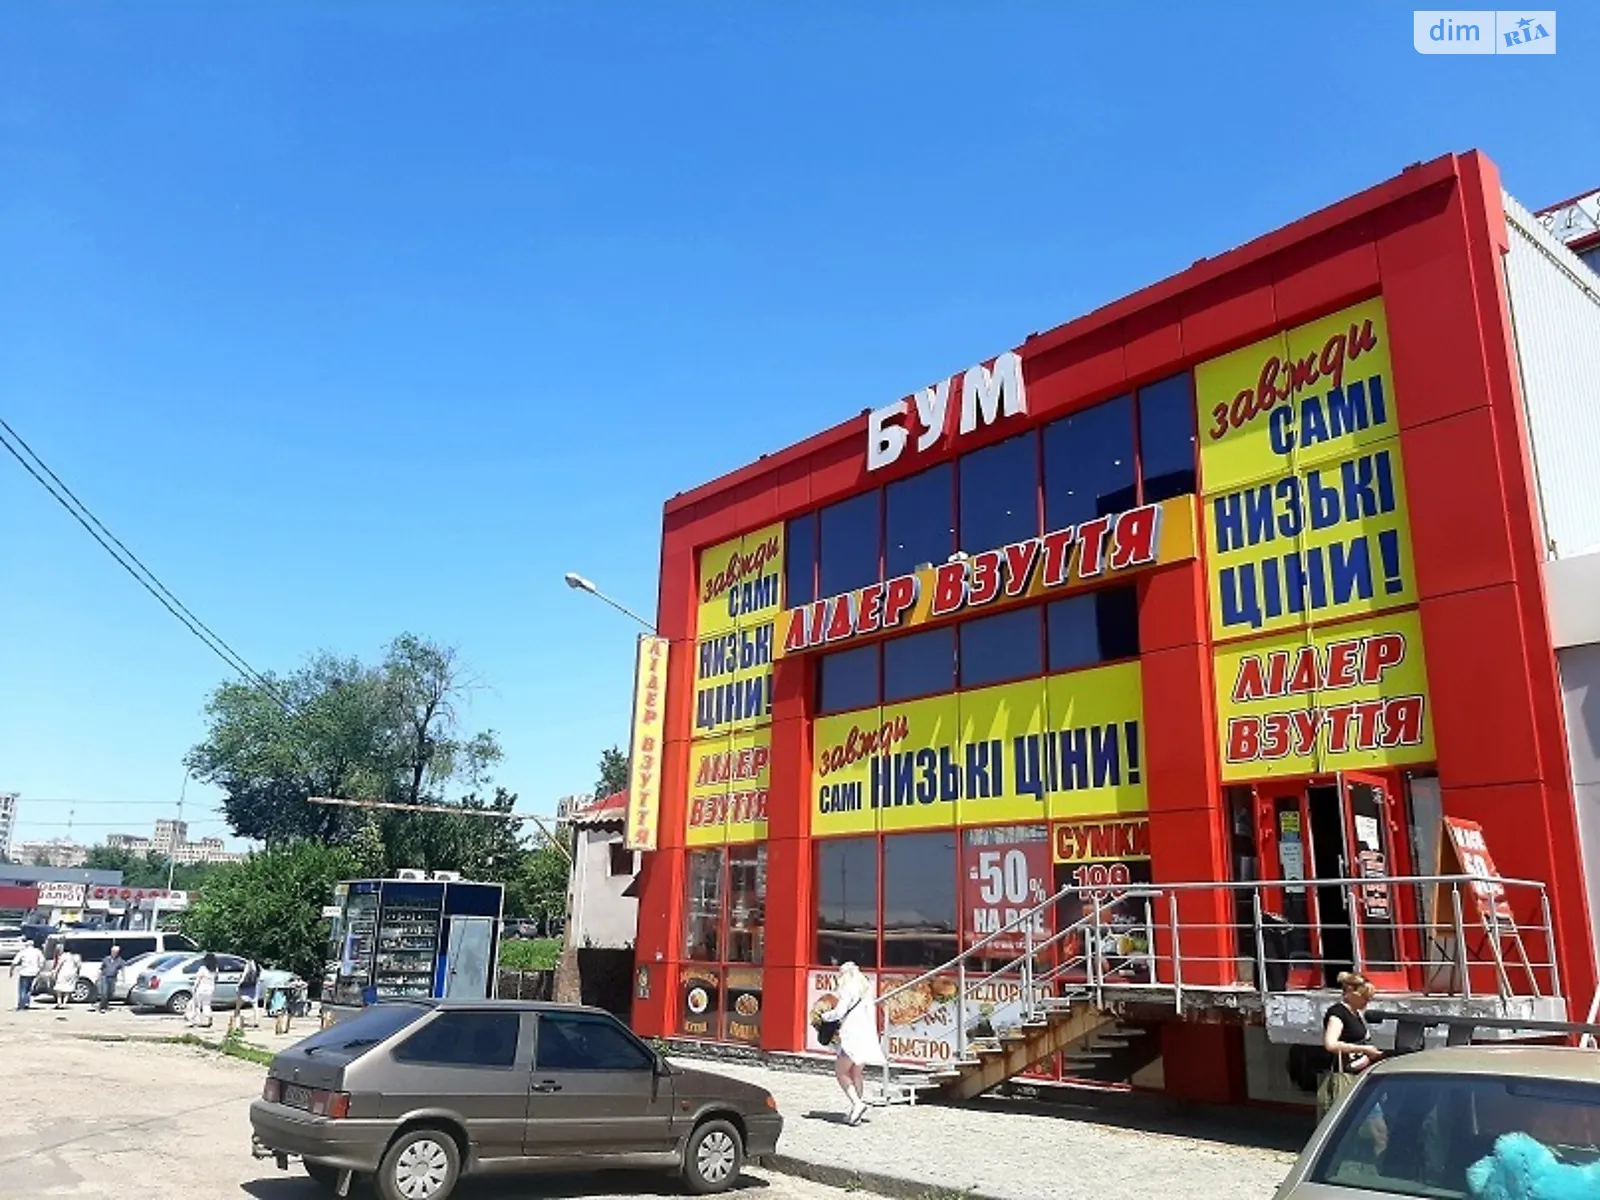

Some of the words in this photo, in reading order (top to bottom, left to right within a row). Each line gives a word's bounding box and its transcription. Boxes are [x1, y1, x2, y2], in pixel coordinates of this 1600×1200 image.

[867, 351, 1028, 471] БУМ
[1209, 317, 1377, 440] завжди
[1268, 374, 1387, 456] САМІ
[1214, 450, 1395, 554] НИЗЬКІ
[703, 535, 779, 604] завжди
[729, 572, 779, 618] САМІ
[784, 575, 918, 652] ЛІДЕР
[932, 503, 1161, 617] ВЗУТТЯ
[643, 639, 660, 724] ЛІДЕР
[1231, 632, 1405, 702] ЛІДЕР
[818, 714, 909, 778] завжди
[1225, 695, 1424, 763] ВЗУТТЯ
[635, 737, 655, 844] ВЗУТТЯ
[695, 747, 769, 787] ЛІДЕР
[819, 781, 862, 814] САМІ
[870, 739, 1003, 809] НИЗЬКІ
[689, 789, 768, 827] ВЗУТТЯ
[1057, 822, 1149, 860] СУМКИ
[974, 907, 1000, 933] НА
[888, 1037, 951, 1060] БЫСТРО
